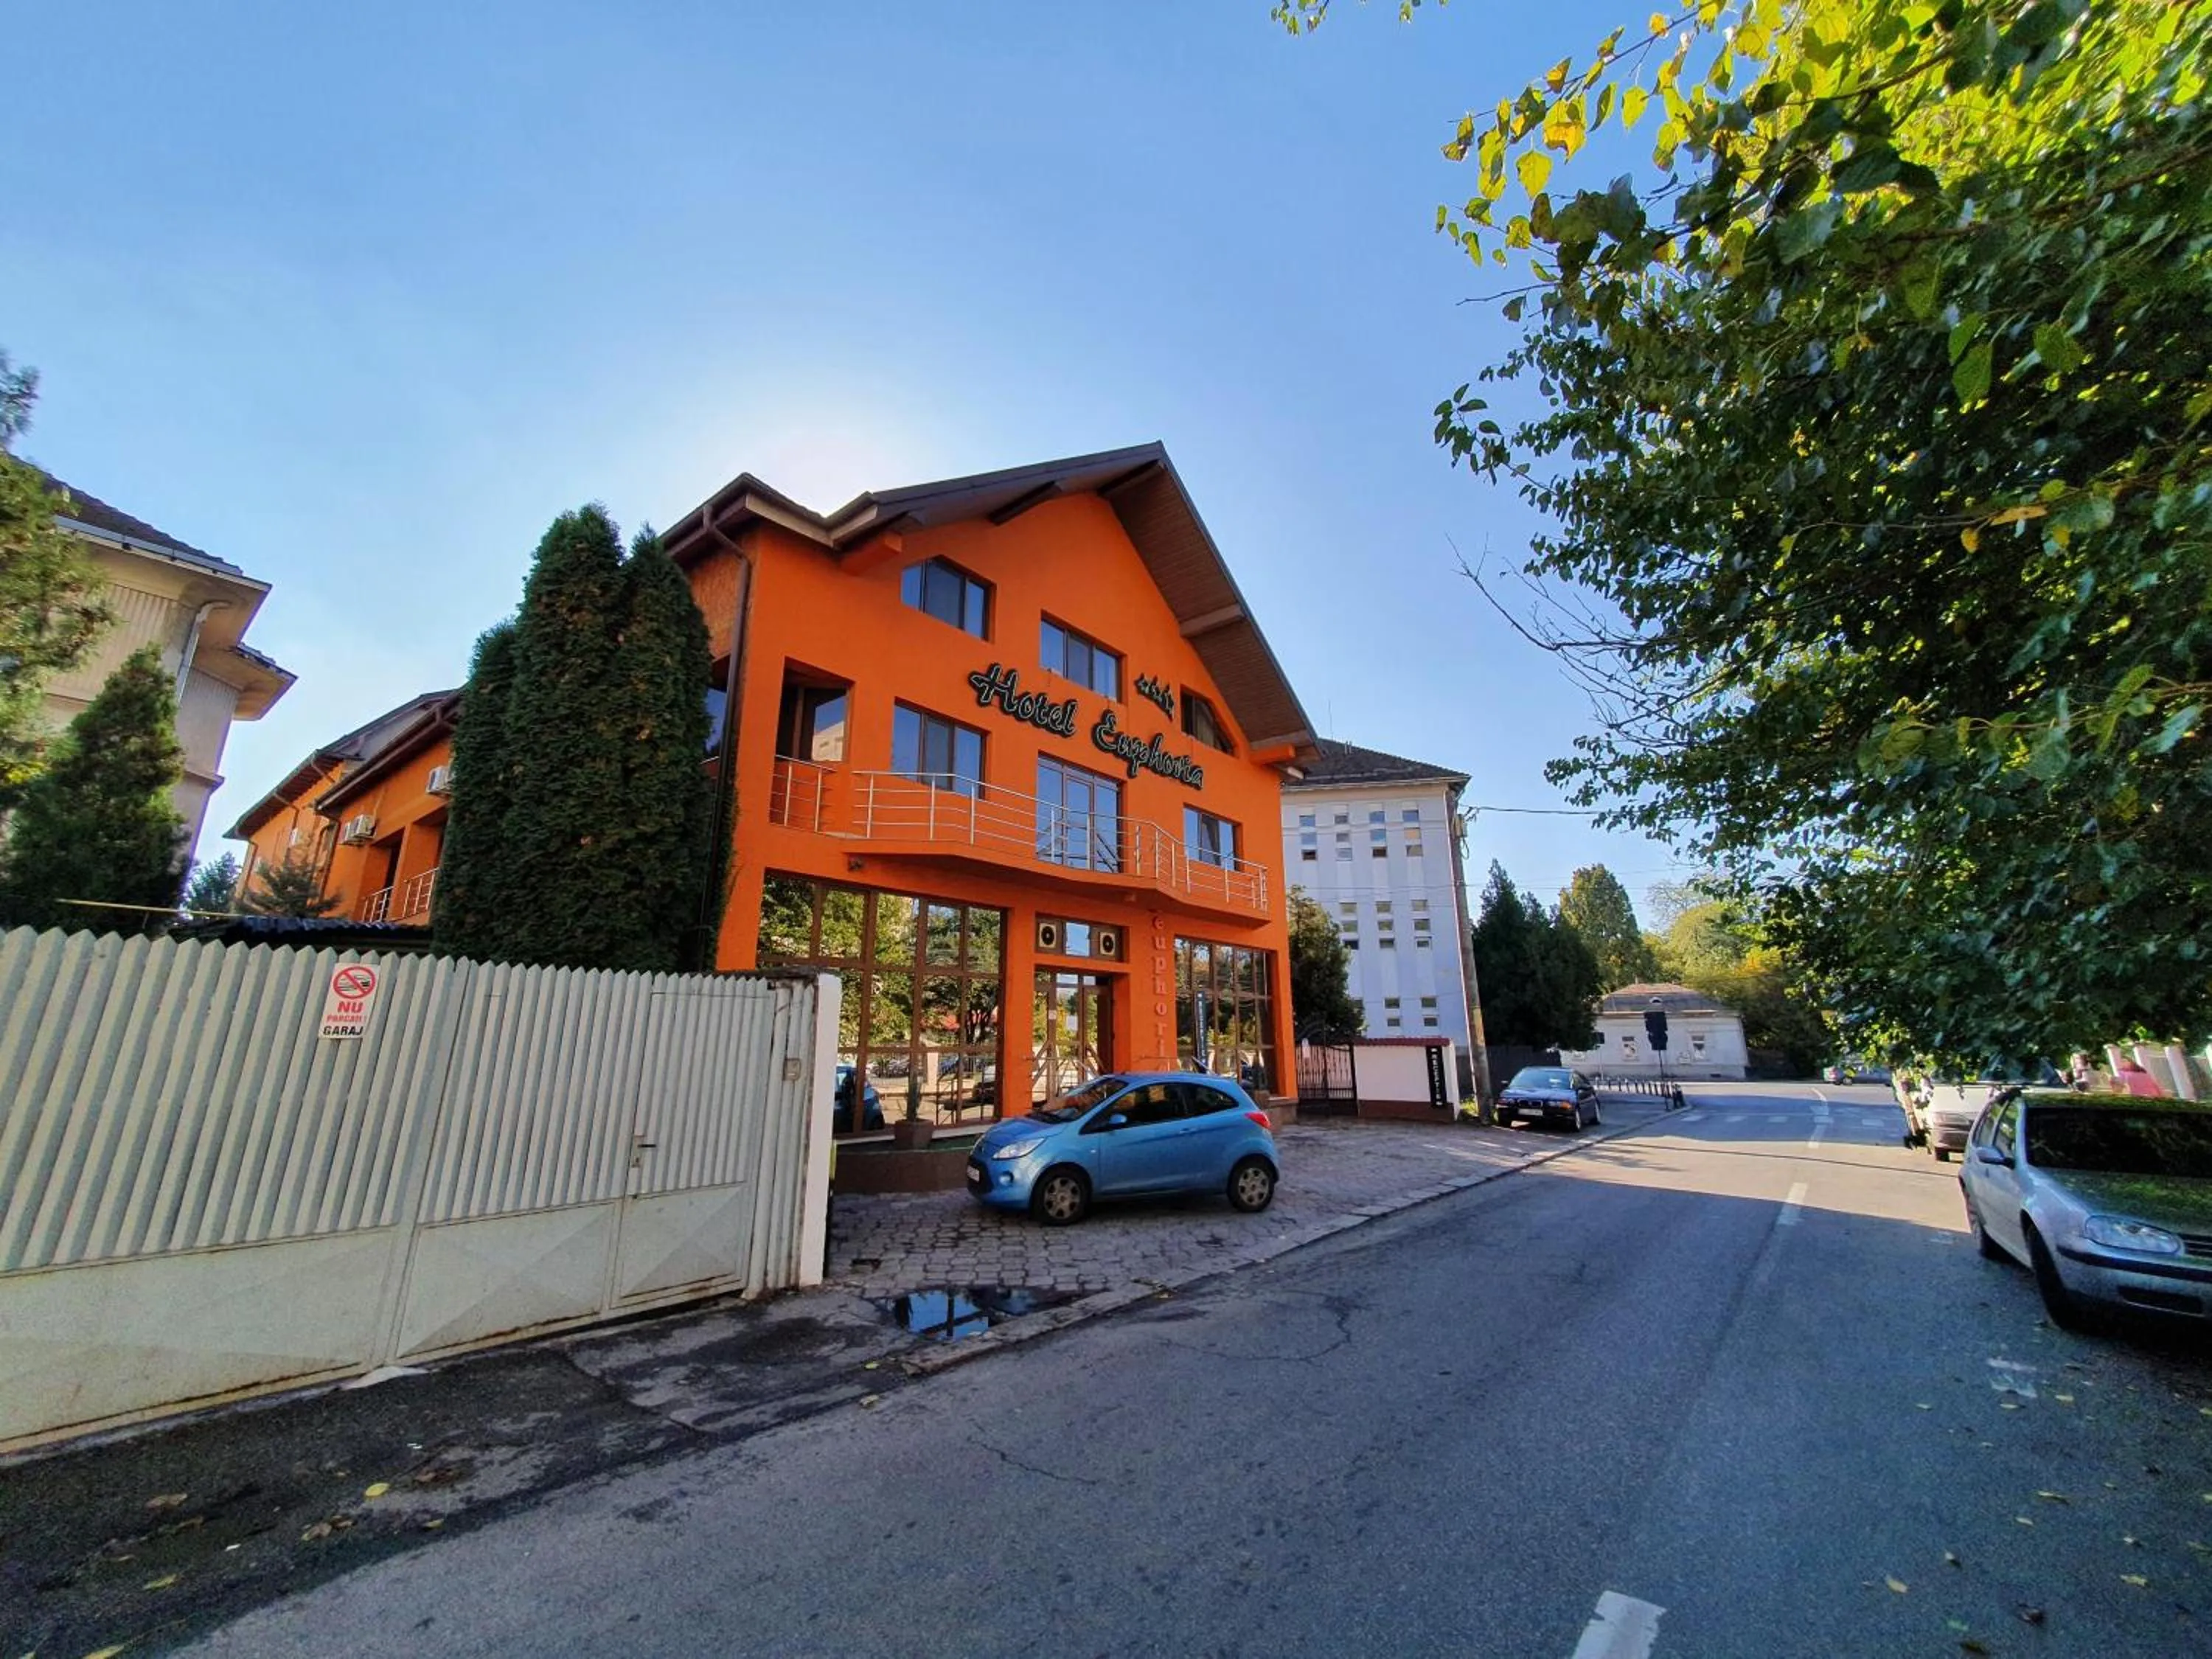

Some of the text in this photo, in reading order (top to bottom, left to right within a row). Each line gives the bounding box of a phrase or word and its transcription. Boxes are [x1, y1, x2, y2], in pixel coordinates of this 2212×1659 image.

[968, 662, 1203, 790] Hotel Euphoria
[337, 1001, 364, 1013] NU
[323, 1026, 364, 1035] GARAJ
